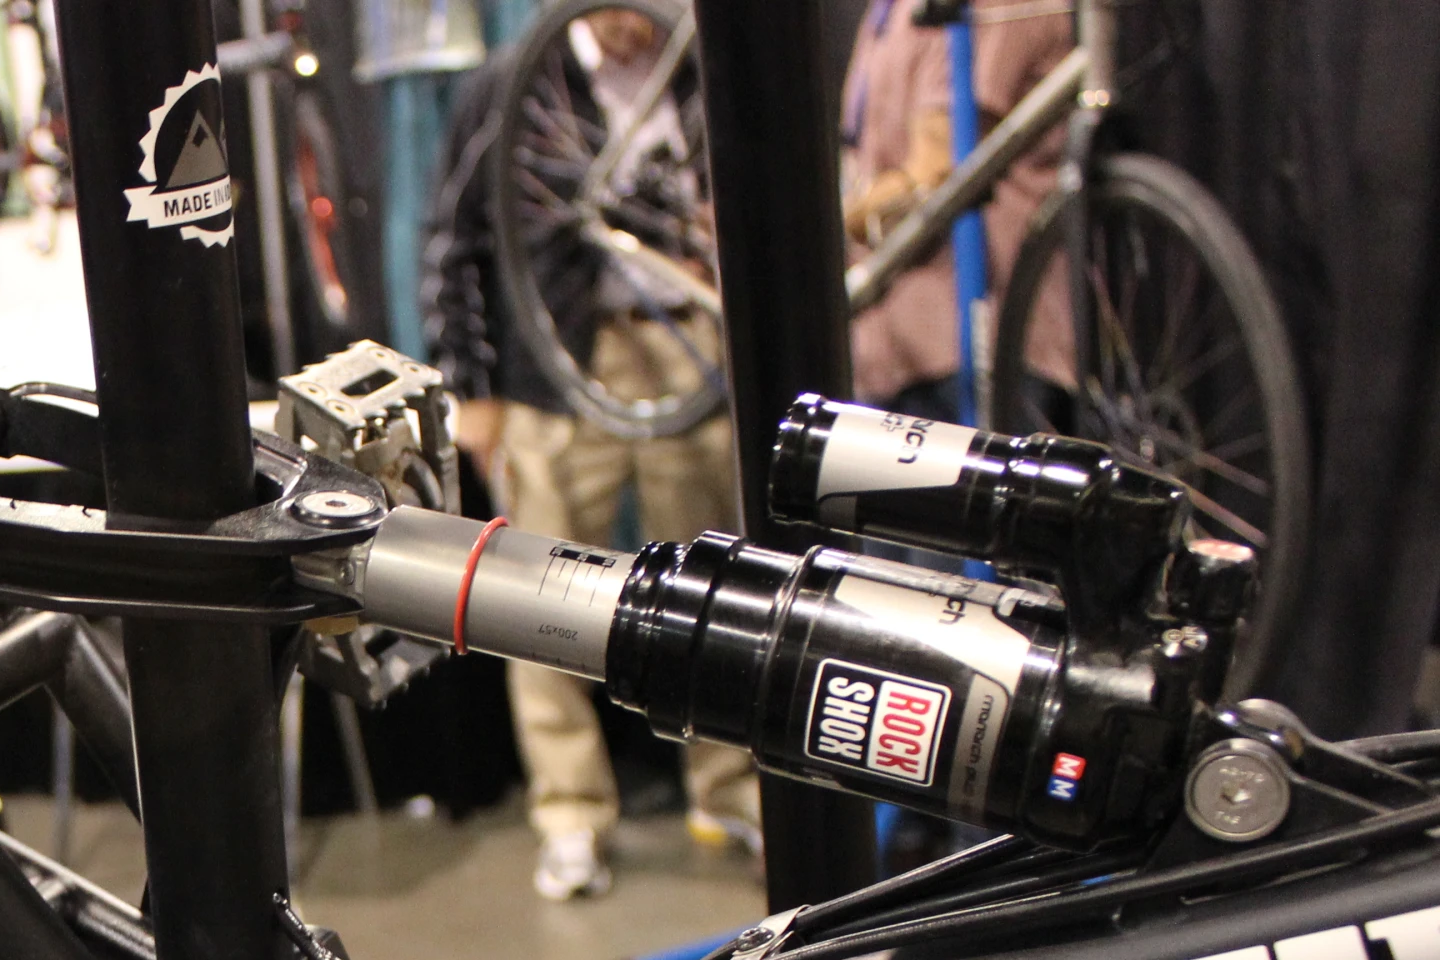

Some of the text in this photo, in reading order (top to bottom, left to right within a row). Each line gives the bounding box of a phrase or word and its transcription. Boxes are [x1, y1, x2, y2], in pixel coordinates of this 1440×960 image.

[163, 192, 213, 218] MADE
[817, 676, 876, 761] SHOX
[875, 690, 933, 775] ROCK
[969, 693, 994, 764] monarch
